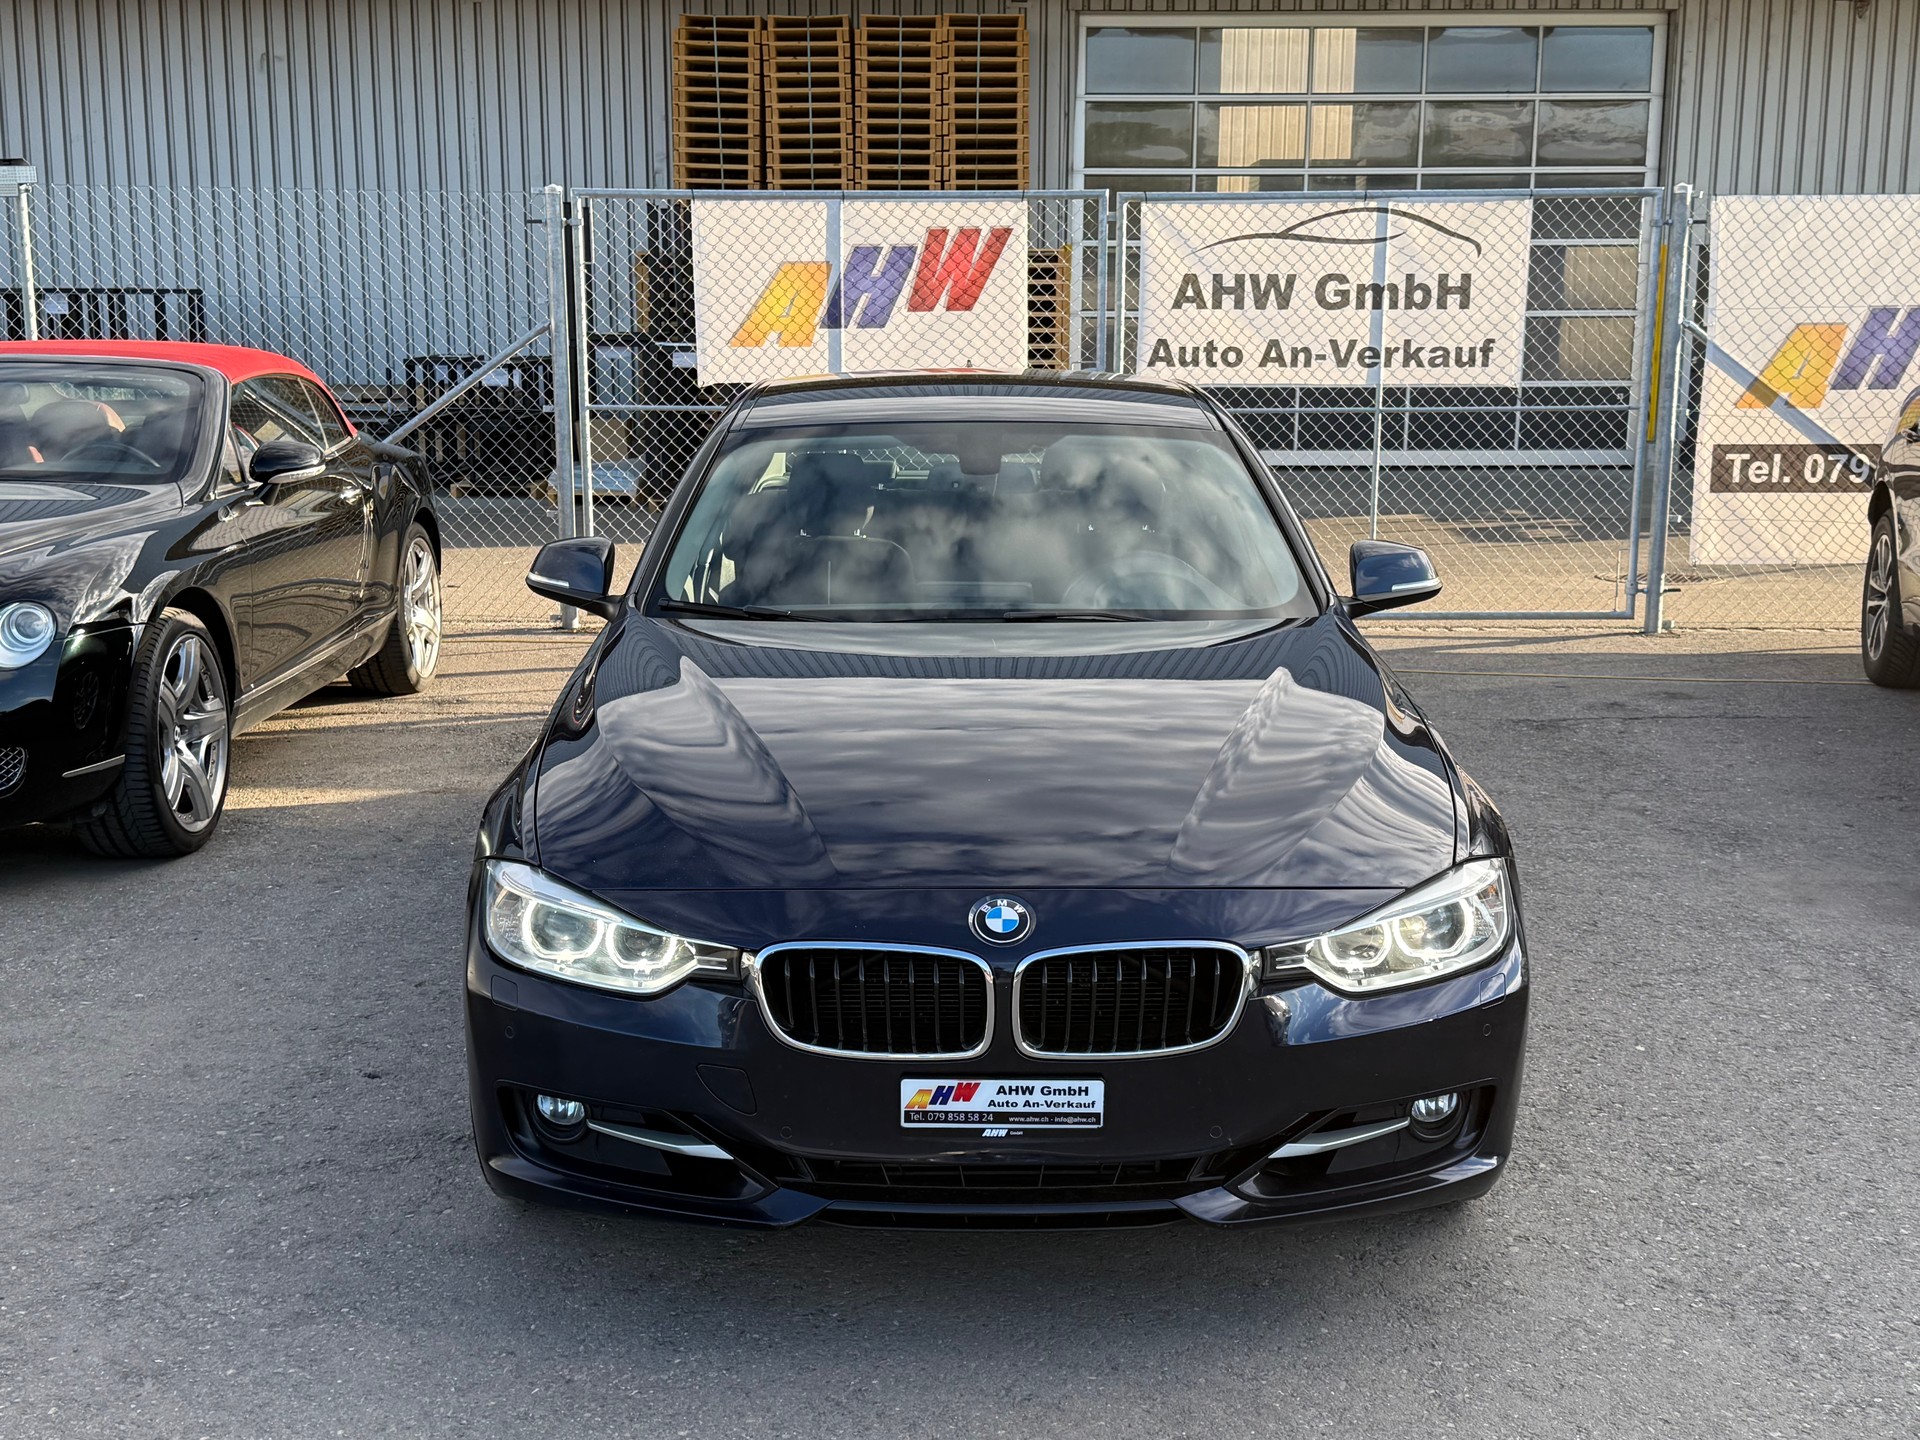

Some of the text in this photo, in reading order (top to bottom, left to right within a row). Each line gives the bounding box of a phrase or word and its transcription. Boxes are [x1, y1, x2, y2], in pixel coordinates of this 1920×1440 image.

[728, 226, 1013, 348] AHW
[1171, 272, 1472, 311] AHW GmbH
[1147, 337, 1496, 369] Auto An-Verkauf
[1725, 453, 1870, 484] Tel. 079
[980, 899, 1026, 914] BMW
[904, 1082, 981, 1109] AHW
[996, 1085, 1089, 1096] AHW GmbH
[987, 1099, 1096, 1109] Auto An-Verkauf
[909, 1112, 994, 1121] Tel. 079 858 58 24
[1054, 1116, 1096, 1124] info@ahw.ch
[982, 1128, 1008, 1137] AHW
